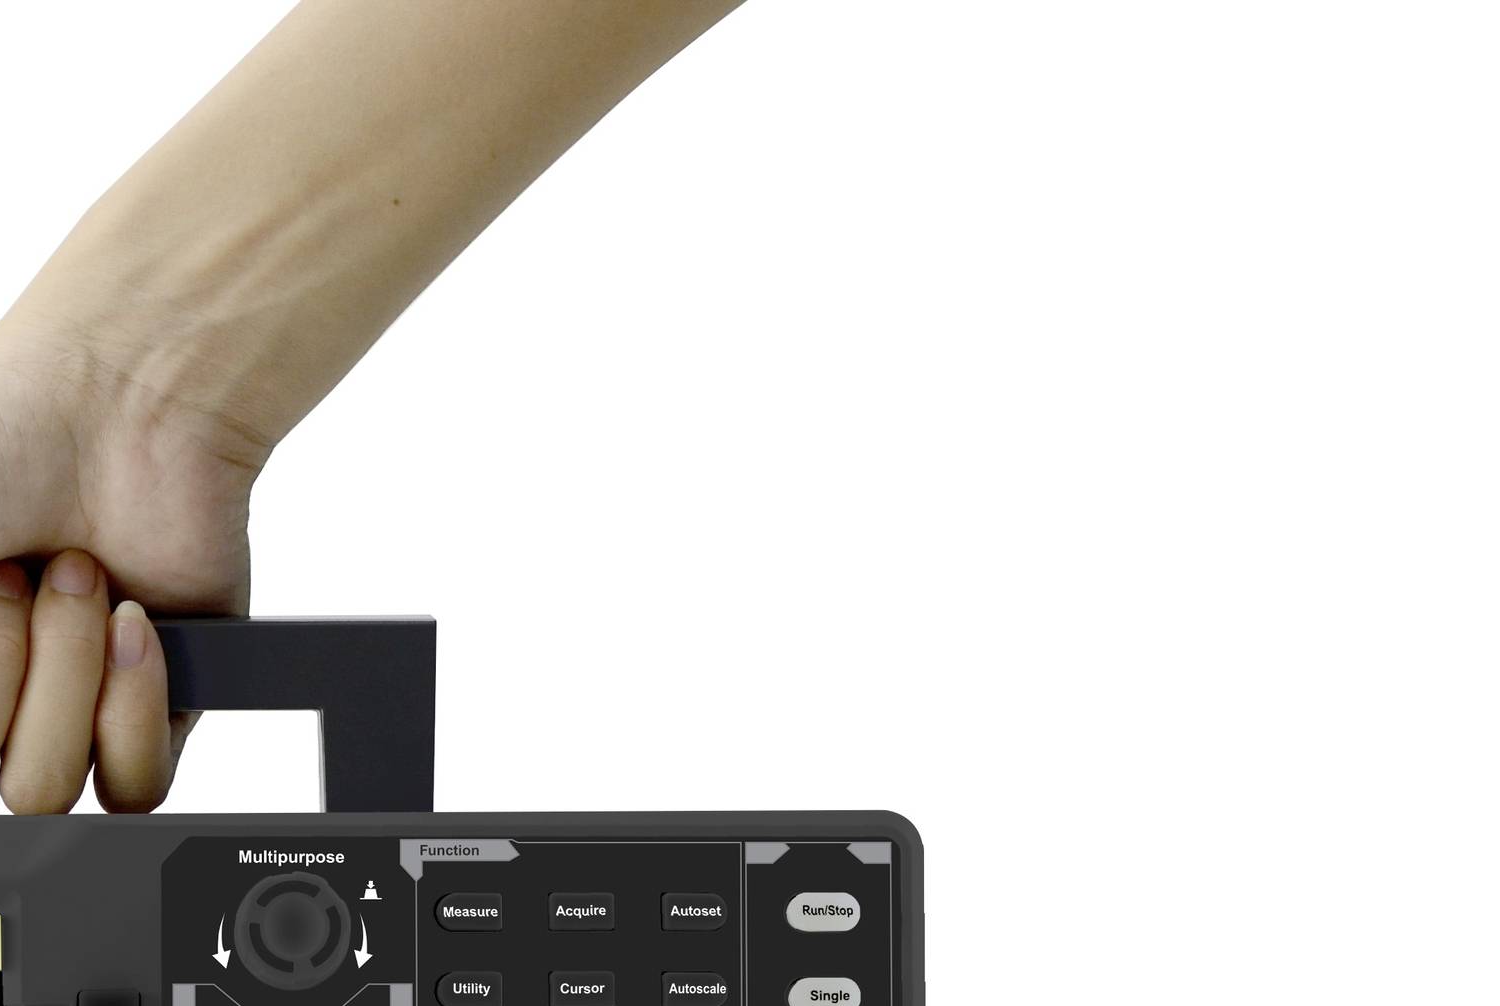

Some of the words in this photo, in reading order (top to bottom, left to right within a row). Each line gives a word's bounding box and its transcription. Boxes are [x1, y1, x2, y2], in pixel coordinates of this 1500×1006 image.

[420, 845, 479, 856] Function
[239, 850, 344, 864] Multipurpose
[444, 907, 498, 917] Measure
[556, 905, 606, 918] Acquire
[671, 906, 721, 916] Autoset
[803, 905, 853, 917] Run/Stop
[454, 983, 490, 996] Utility
[561, 983, 605, 994] Cursor
[669, 983, 726, 994] Autoscale
[811, 990, 849, 1003] Single
